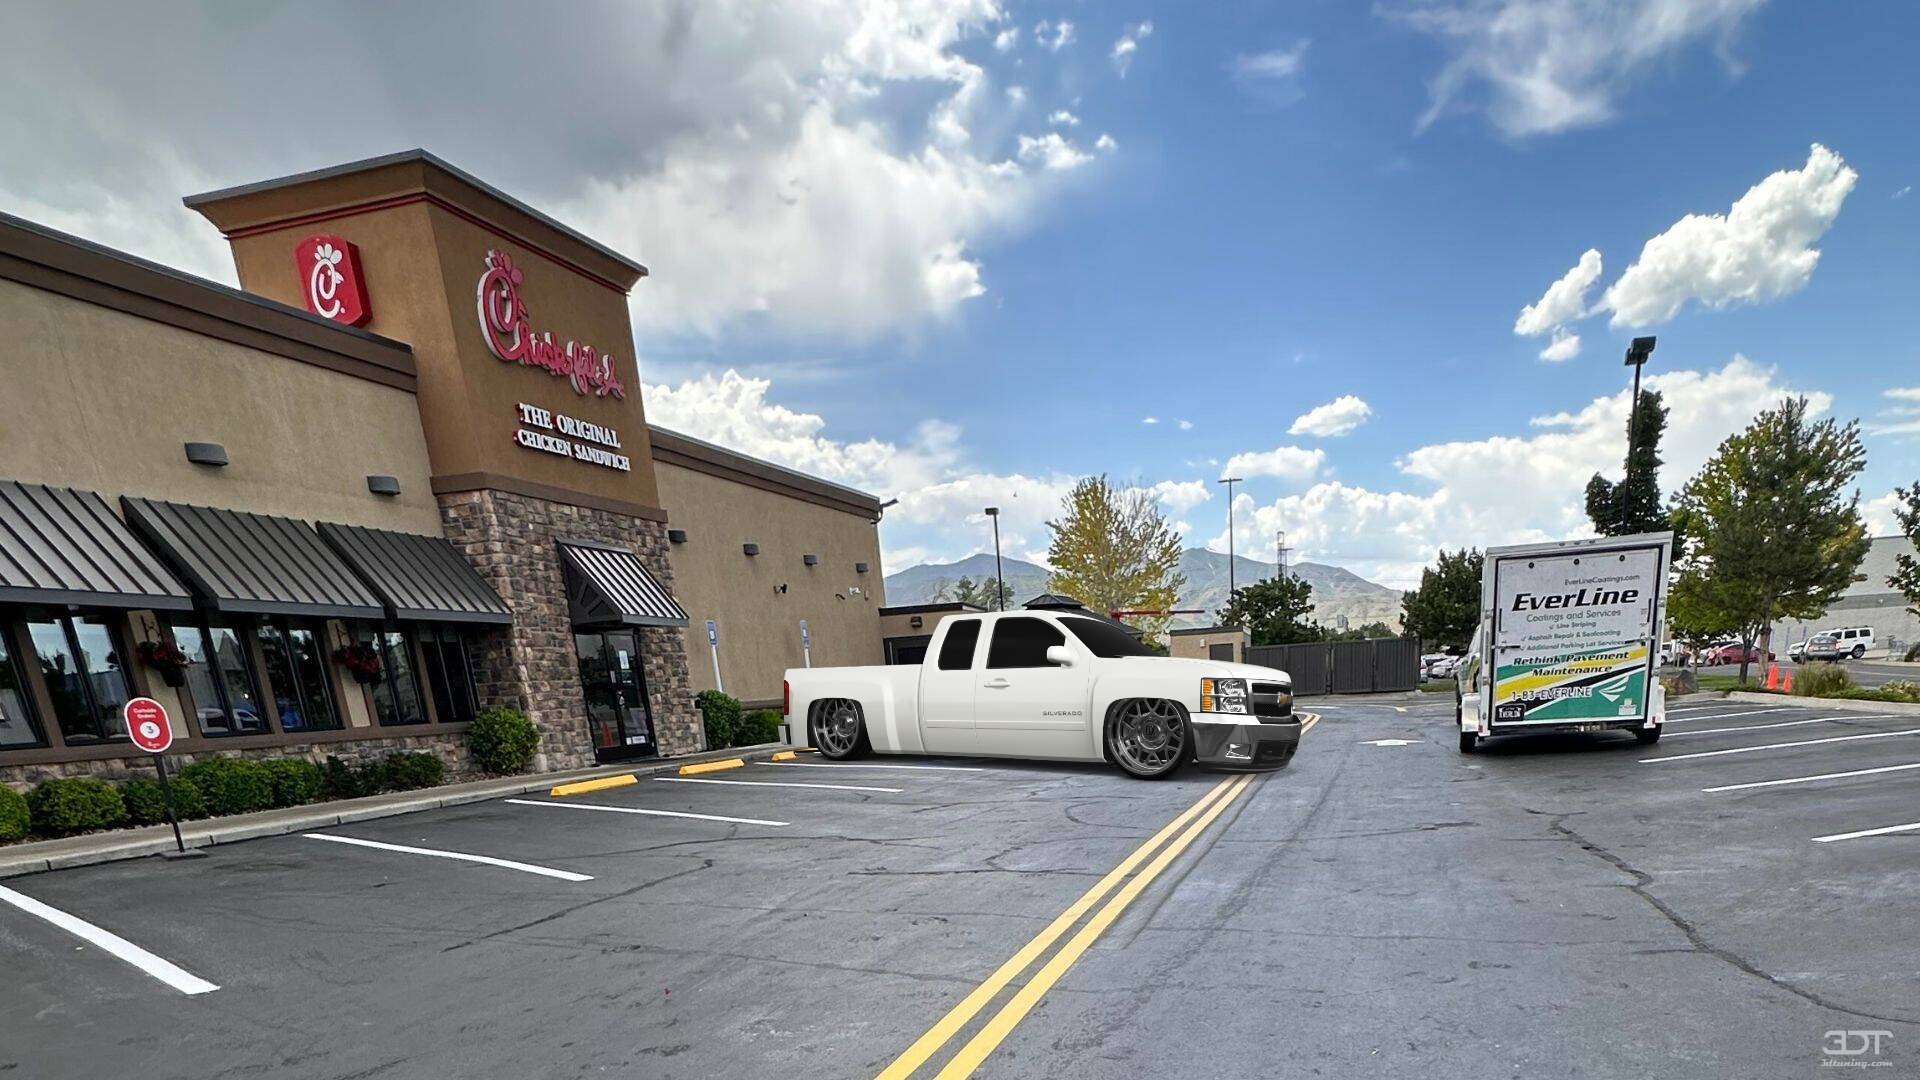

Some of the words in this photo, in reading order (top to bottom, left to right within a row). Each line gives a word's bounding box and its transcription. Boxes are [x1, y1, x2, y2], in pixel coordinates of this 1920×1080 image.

[519, 402, 553, 430] THE
[556, 414, 621, 448] ORIGINAL
[517, 428, 574, 457] CHICKEN
[574, 444, 631, 472] SANDWICH
[1564, 575, 1640, 585] EverLineCoatings.com
[1512, 588, 1639, 611] EverLine
[1526, 611, 1564, 623] Coatings
[1566, 609, 1584, 619] and
[1586, 608, 1622, 619] Services
[1554, 631, 1575, 640] Repair
[1560, 641, 1585, 649] Parking
[1513, 655, 1561, 666] Rethink
[1566, 651, 1630, 662] Pavement
[1532, 665, 1613, 677] Maintenance
[146, 726, 154, 734] 3
